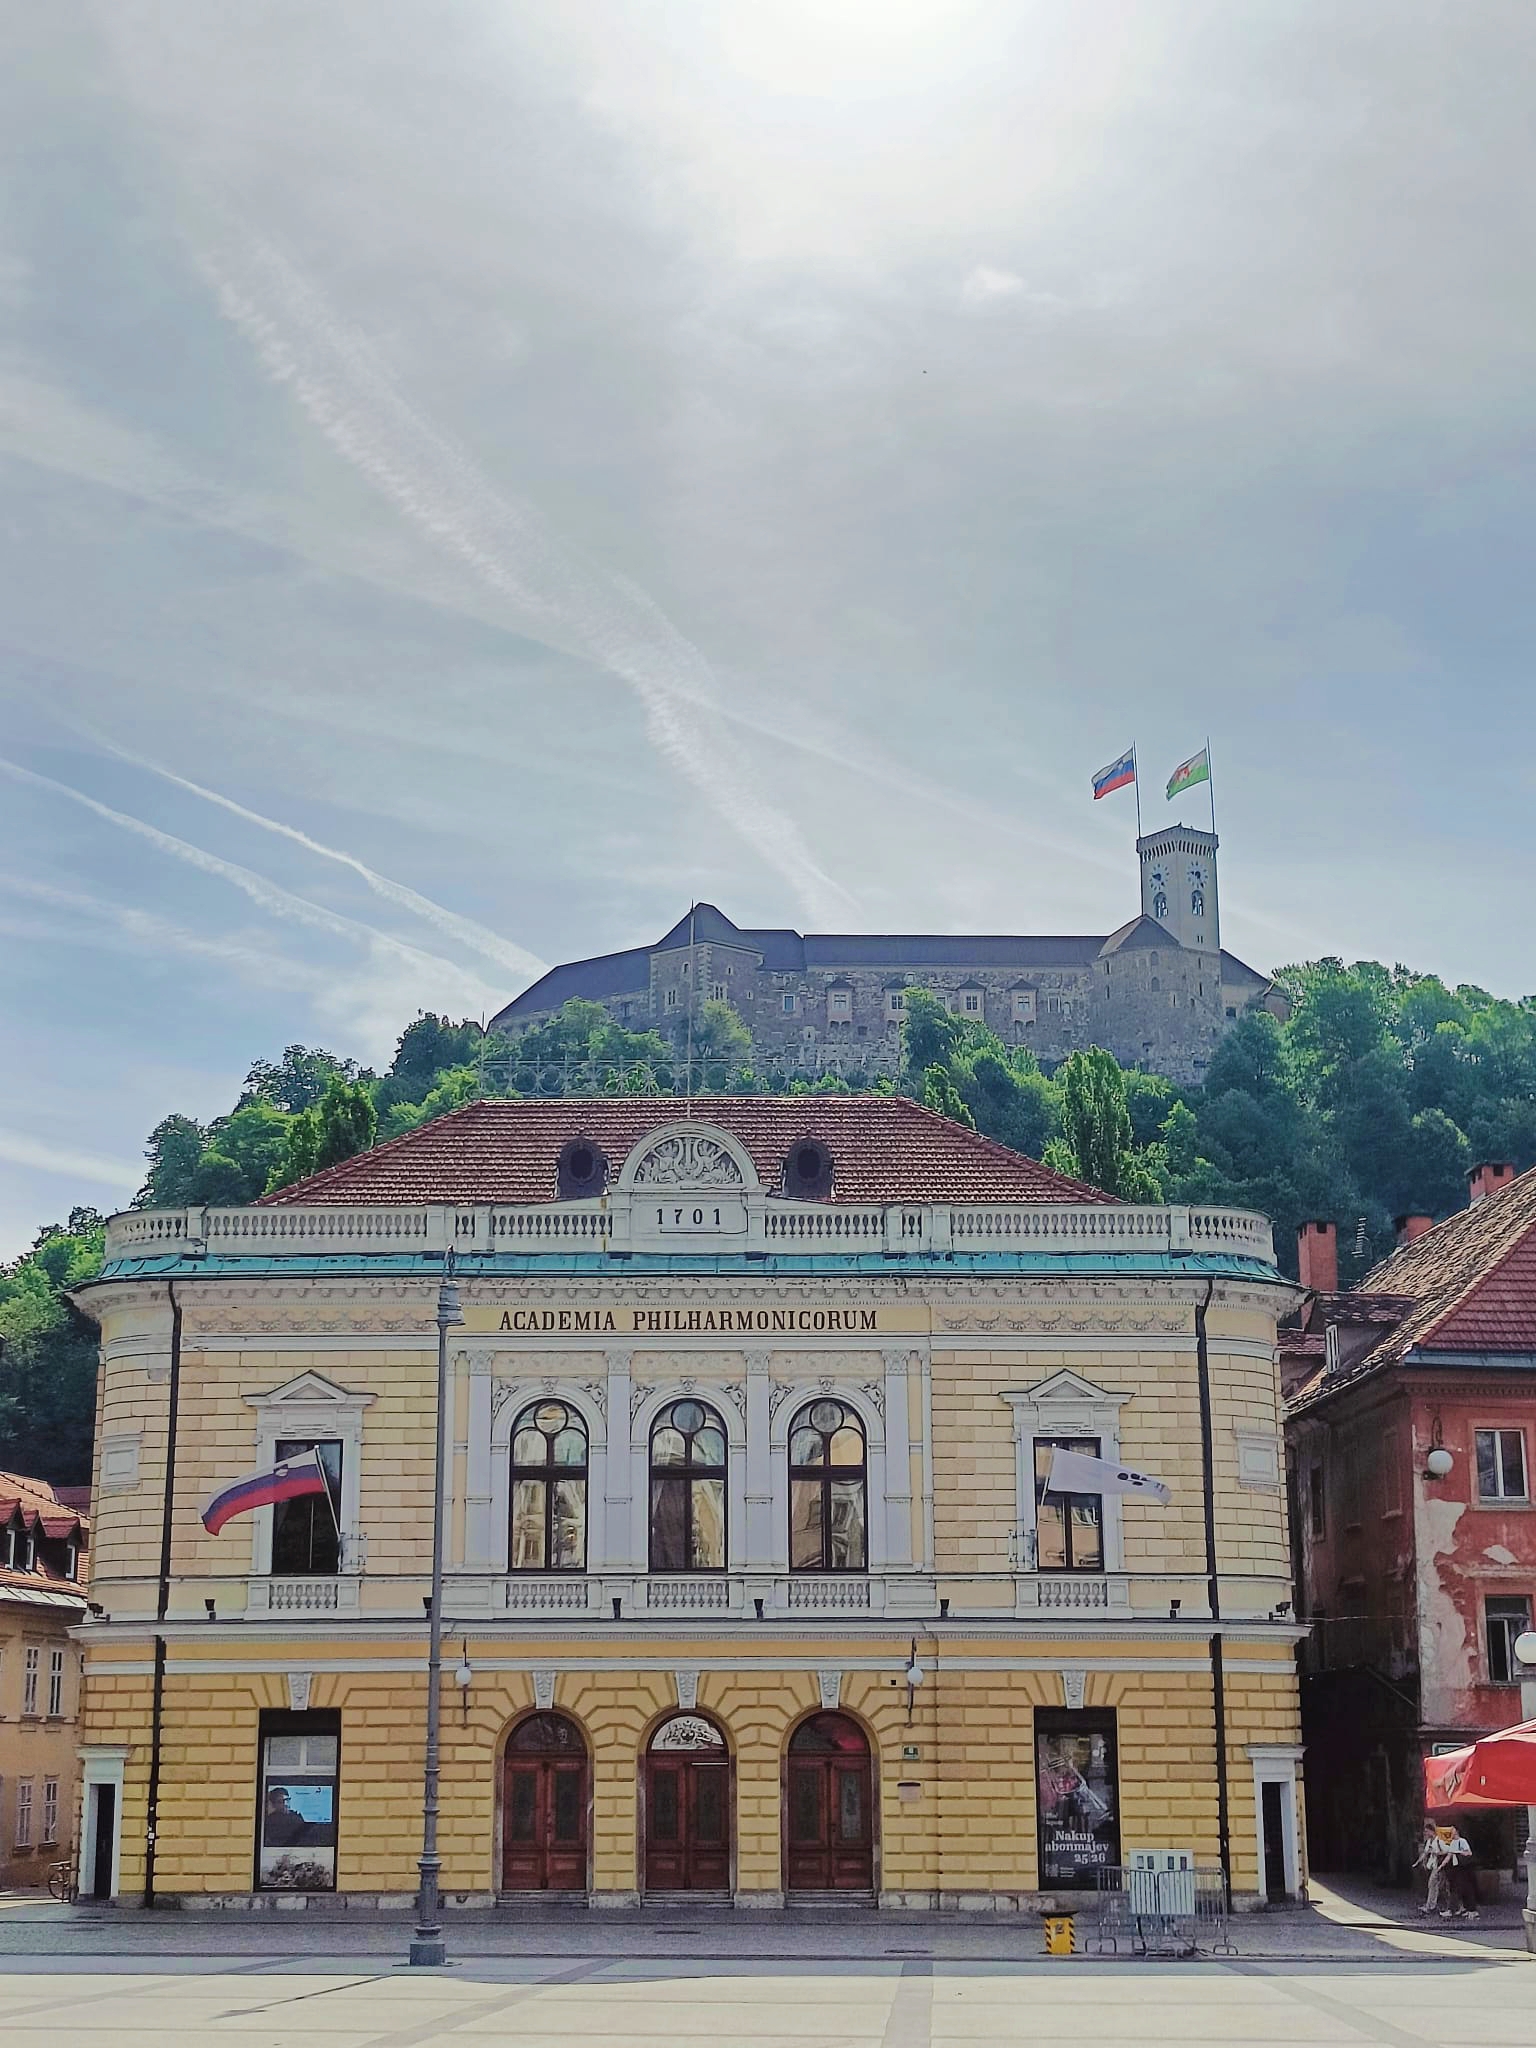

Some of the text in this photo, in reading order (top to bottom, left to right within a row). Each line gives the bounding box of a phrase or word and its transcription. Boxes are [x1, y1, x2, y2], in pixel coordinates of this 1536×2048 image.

[656, 1208, 721, 1225] 1701
[499, 1310, 878, 1330] ACADEMIA PHILHARMONICORUM
[1055, 1830, 1095, 1842] Nakup
[1044, 1840, 1110, 1853] abonmajev
